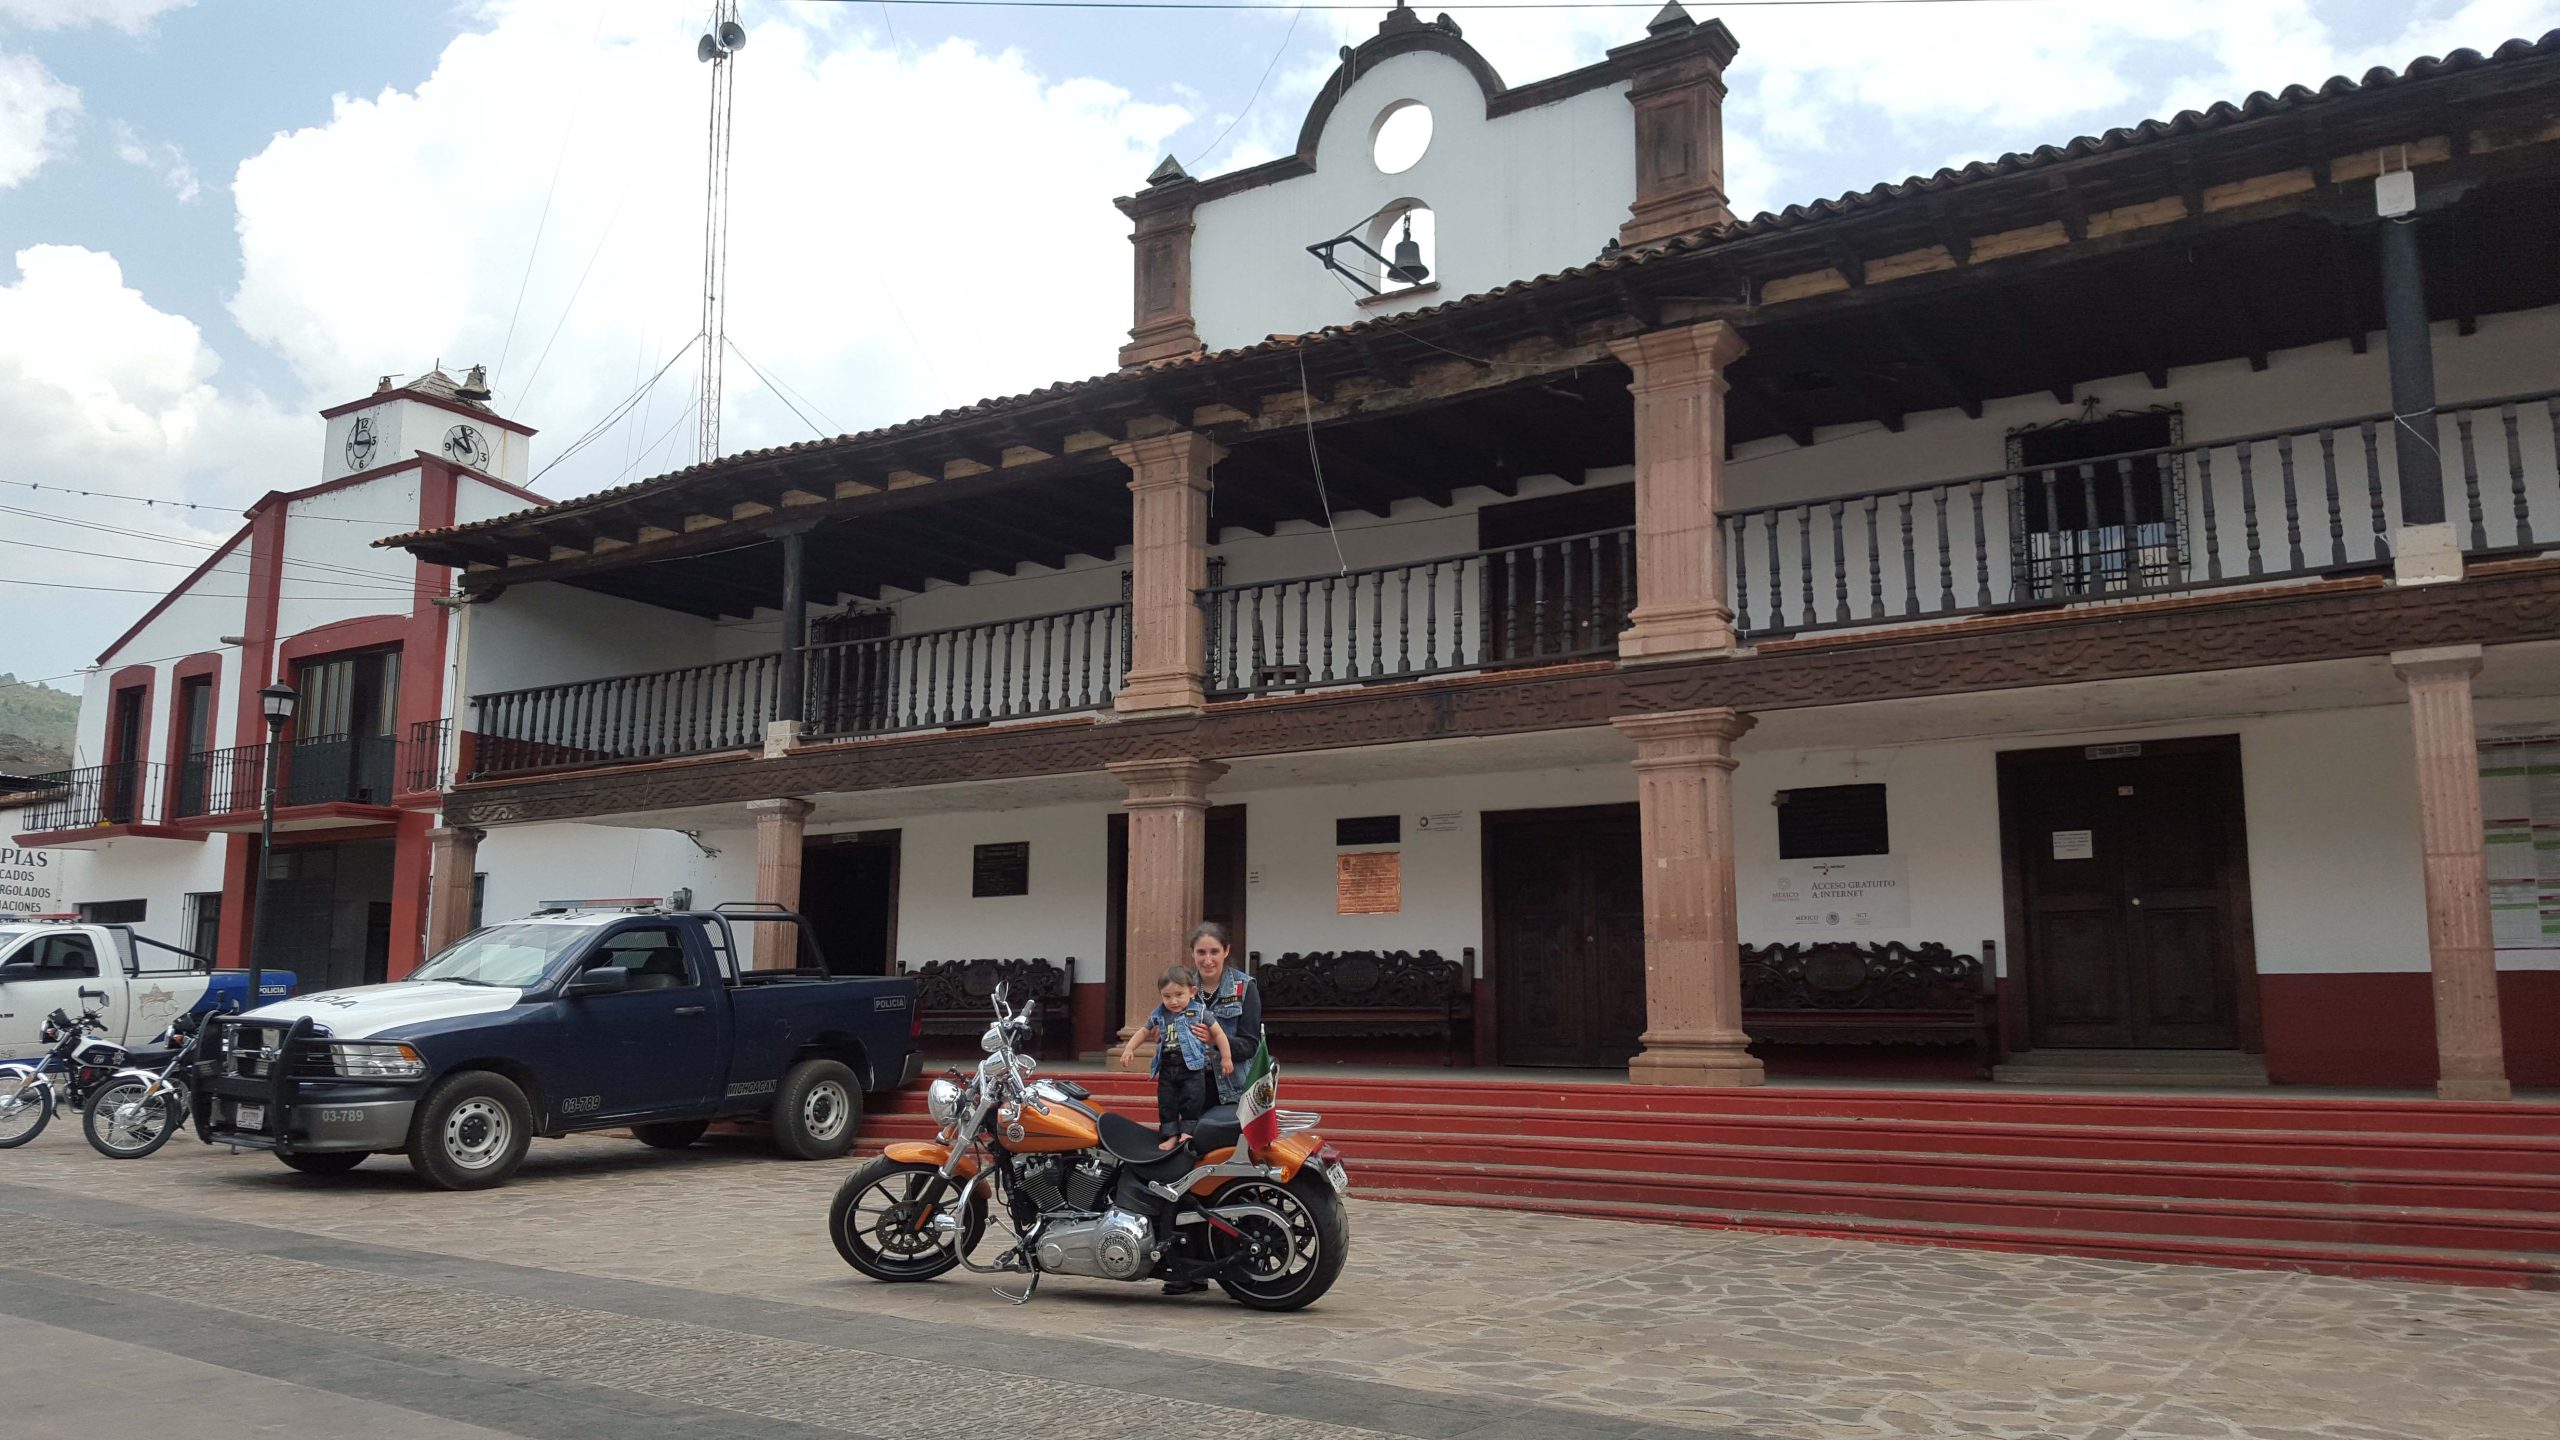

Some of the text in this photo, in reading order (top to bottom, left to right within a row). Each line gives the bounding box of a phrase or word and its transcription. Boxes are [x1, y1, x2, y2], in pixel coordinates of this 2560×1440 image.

[361, 420, 369, 429] 12
[371, 436, 377, 446] 3
[347, 442, 353, 451] 9
[444, 442, 452, 451] 9
[480, 452, 487, 462] 3
[359, 460, 364, 469] 6
[0, 848, 48, 867] PIAS
[1812, 880, 1896, 890] ACCESO GRATUITO
[1812, 889, 1864, 899] A INTERNET
[0, 900, 41, 913] ACIONES
[562, 1095, 600, 1114] 03-789
[322, 1110, 364, 1122] 03-789
